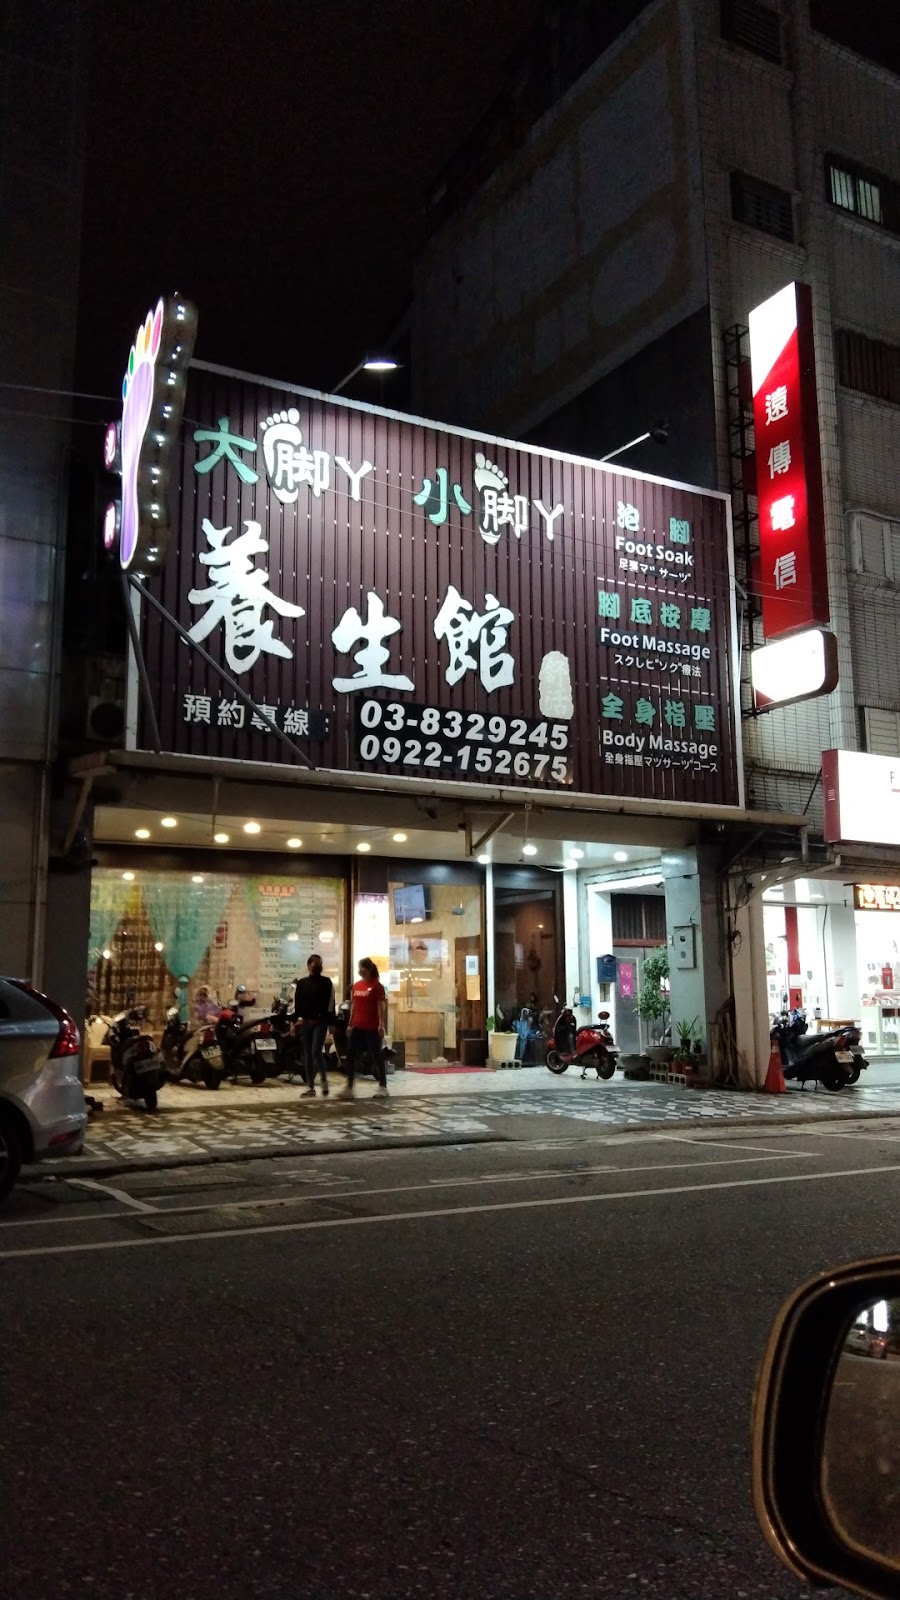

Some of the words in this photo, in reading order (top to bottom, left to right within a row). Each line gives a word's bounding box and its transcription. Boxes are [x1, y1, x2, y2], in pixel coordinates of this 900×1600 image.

[615, 535, 653, 558] Foot
[655, 545, 694, 566] Soak
[180, 518, 515, 694] 養生館
[598, 589, 711, 633] 腳底按摩
[600, 627, 639, 649] Foot
[642, 634, 711, 661] Massage
[360, 700, 569, 750] 03-8329245
[602, 729, 646, 752] Body
[649, 734, 718, 760] Massage
[360, 734, 568, 781] 0922-152675
